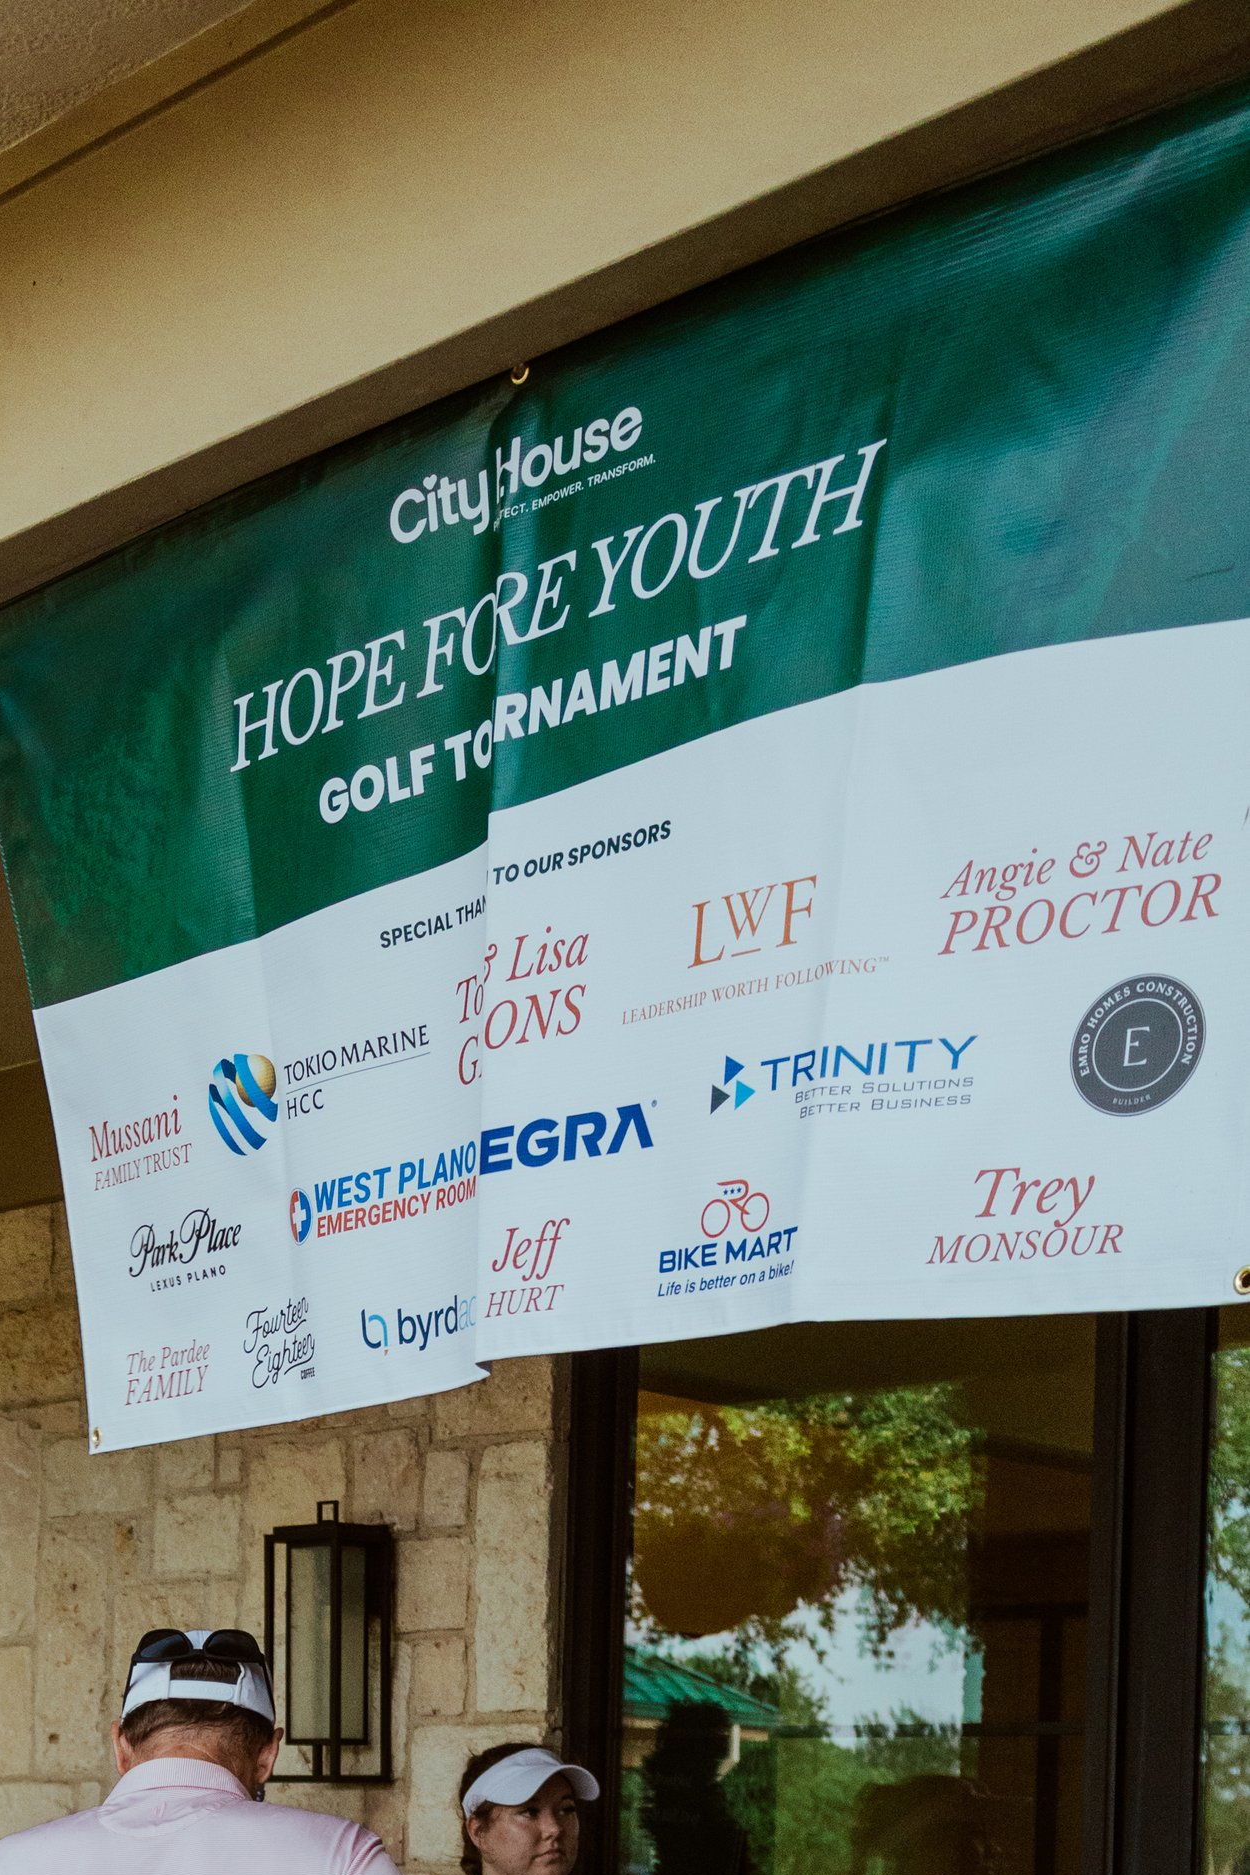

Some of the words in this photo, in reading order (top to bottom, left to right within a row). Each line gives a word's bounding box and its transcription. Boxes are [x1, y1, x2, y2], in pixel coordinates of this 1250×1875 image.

[389, 474, 491, 545] City
[495, 406, 643, 505] House
[531, 482, 584, 511] EMPOWER.
[587, 454, 656, 488] TRANSFORM.
[229, 629, 406, 772] HOPE
[416, 549, 578, 700] FORE
[588, 438, 887, 617] YOUTH
[319, 744, 436, 824] GOLF
[380, 913, 453, 948] SPECIAL
[493, 864, 519, 885] TO
[524, 852, 564, 878] OUR
[567, 820, 671, 866] SPONSORS
[940, 848, 1055, 901] Angie
[1069, 840, 1107, 878] &
[1116, 831, 1213, 873] Nate
[687, 875, 817, 968] LWF
[937, 873, 1221, 955] PROCTOR
[506, 926, 589, 982] Lisa
[622, 992, 707, 1025] LEADERSHIP
[712, 977, 769, 1002] WORTH
[1078, 1033, 1091, 1077] EMRO
[1087, 986, 1131, 1029] HOMES
[1136, 981, 1198, 1066] CONSTRUCTION
[284, 1050, 337, 1085] TOKIO
[340, 1024, 430, 1067] MARINE
[760, 1035, 979, 1091] TRINITY
[1122, 1026, 1150, 1067] E
[88, 1095, 182, 1162] Mussani
[286, 1089, 324, 1119] HCC
[94, 1158, 141, 1191] FAMILY
[143, 1143, 192, 1175] TRUST
[314, 1166, 391, 1213] WEST
[398, 1141, 476, 1195] PLANO
[317, 1192, 432, 1238] EMERGENCY
[435, 1175, 477, 1211] ROOM
[974, 1168, 1096, 1228] Trey
[129, 1224, 179, 1277] Park
[179, 1208, 242, 1264] Place
[491, 1217, 571, 1282] Jeff
[658, 1243, 718, 1274] BIKE
[725, 1226, 799, 1264] MART
[925, 1224, 1124, 1264] MONSOUR
[150, 1276, 182, 1292] LEXUS
[188, 1265, 226, 1283] PLANO
[484, 1284, 565, 1319] HURT
[657, 1282, 681, 1297] Life
[684, 1278, 696, 1293] is
[699, 1274, 737, 1292] better
[739, 1273, 756, 1286] on
[758, 1270, 766, 1282] a
[768, 1259, 795, 1279] bike!
[243, 1297, 309, 1354] Fourteen
[125, 1365, 209, 1406] FAMILY
[127, 1350, 155, 1375] The
[160, 1339, 210, 1370] Pardee
[253, 1333, 316, 1389] Eighteen
[300, 1367, 316, 1380] COFFEE
